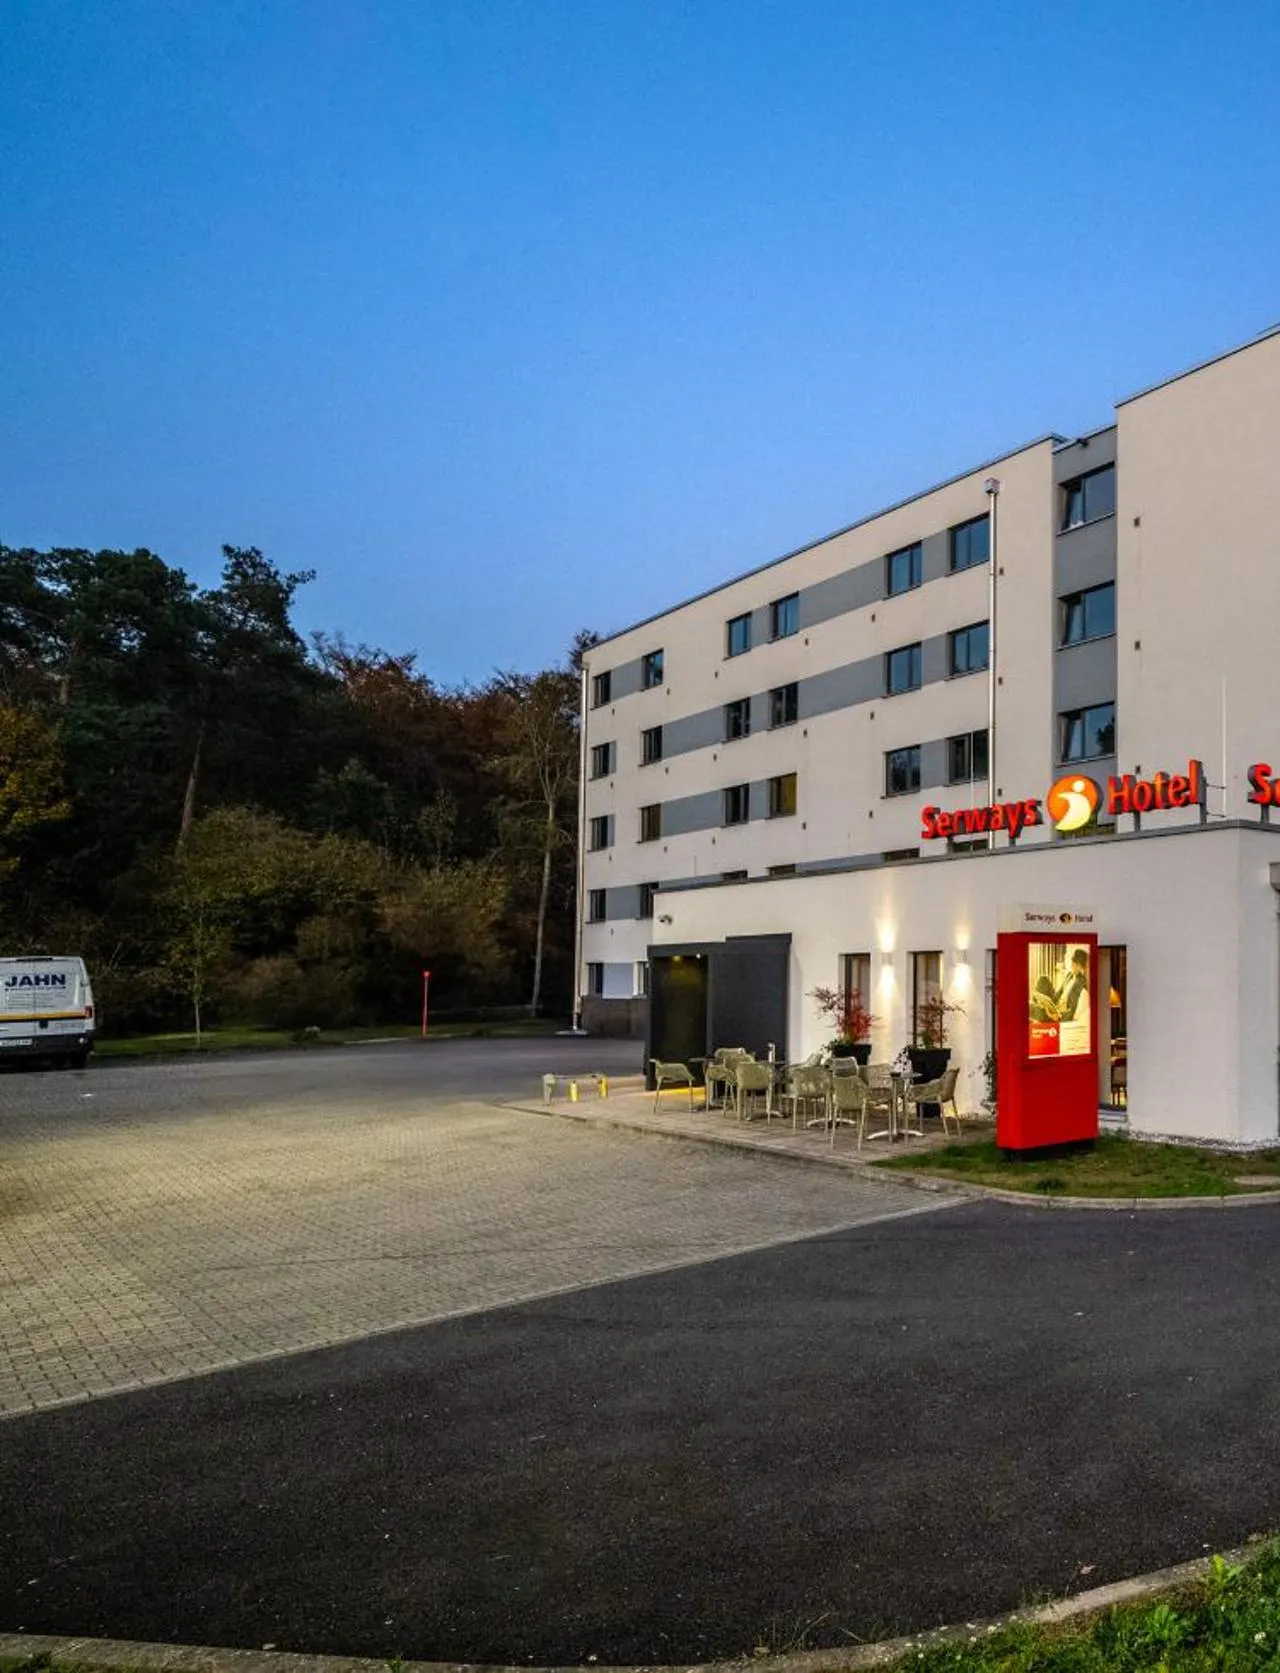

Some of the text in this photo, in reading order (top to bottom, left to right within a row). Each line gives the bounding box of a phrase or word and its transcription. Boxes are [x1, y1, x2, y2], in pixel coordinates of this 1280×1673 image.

[921, 758, 1203, 839] Serways Hotel
[5, 974, 66, 987] JAHN
